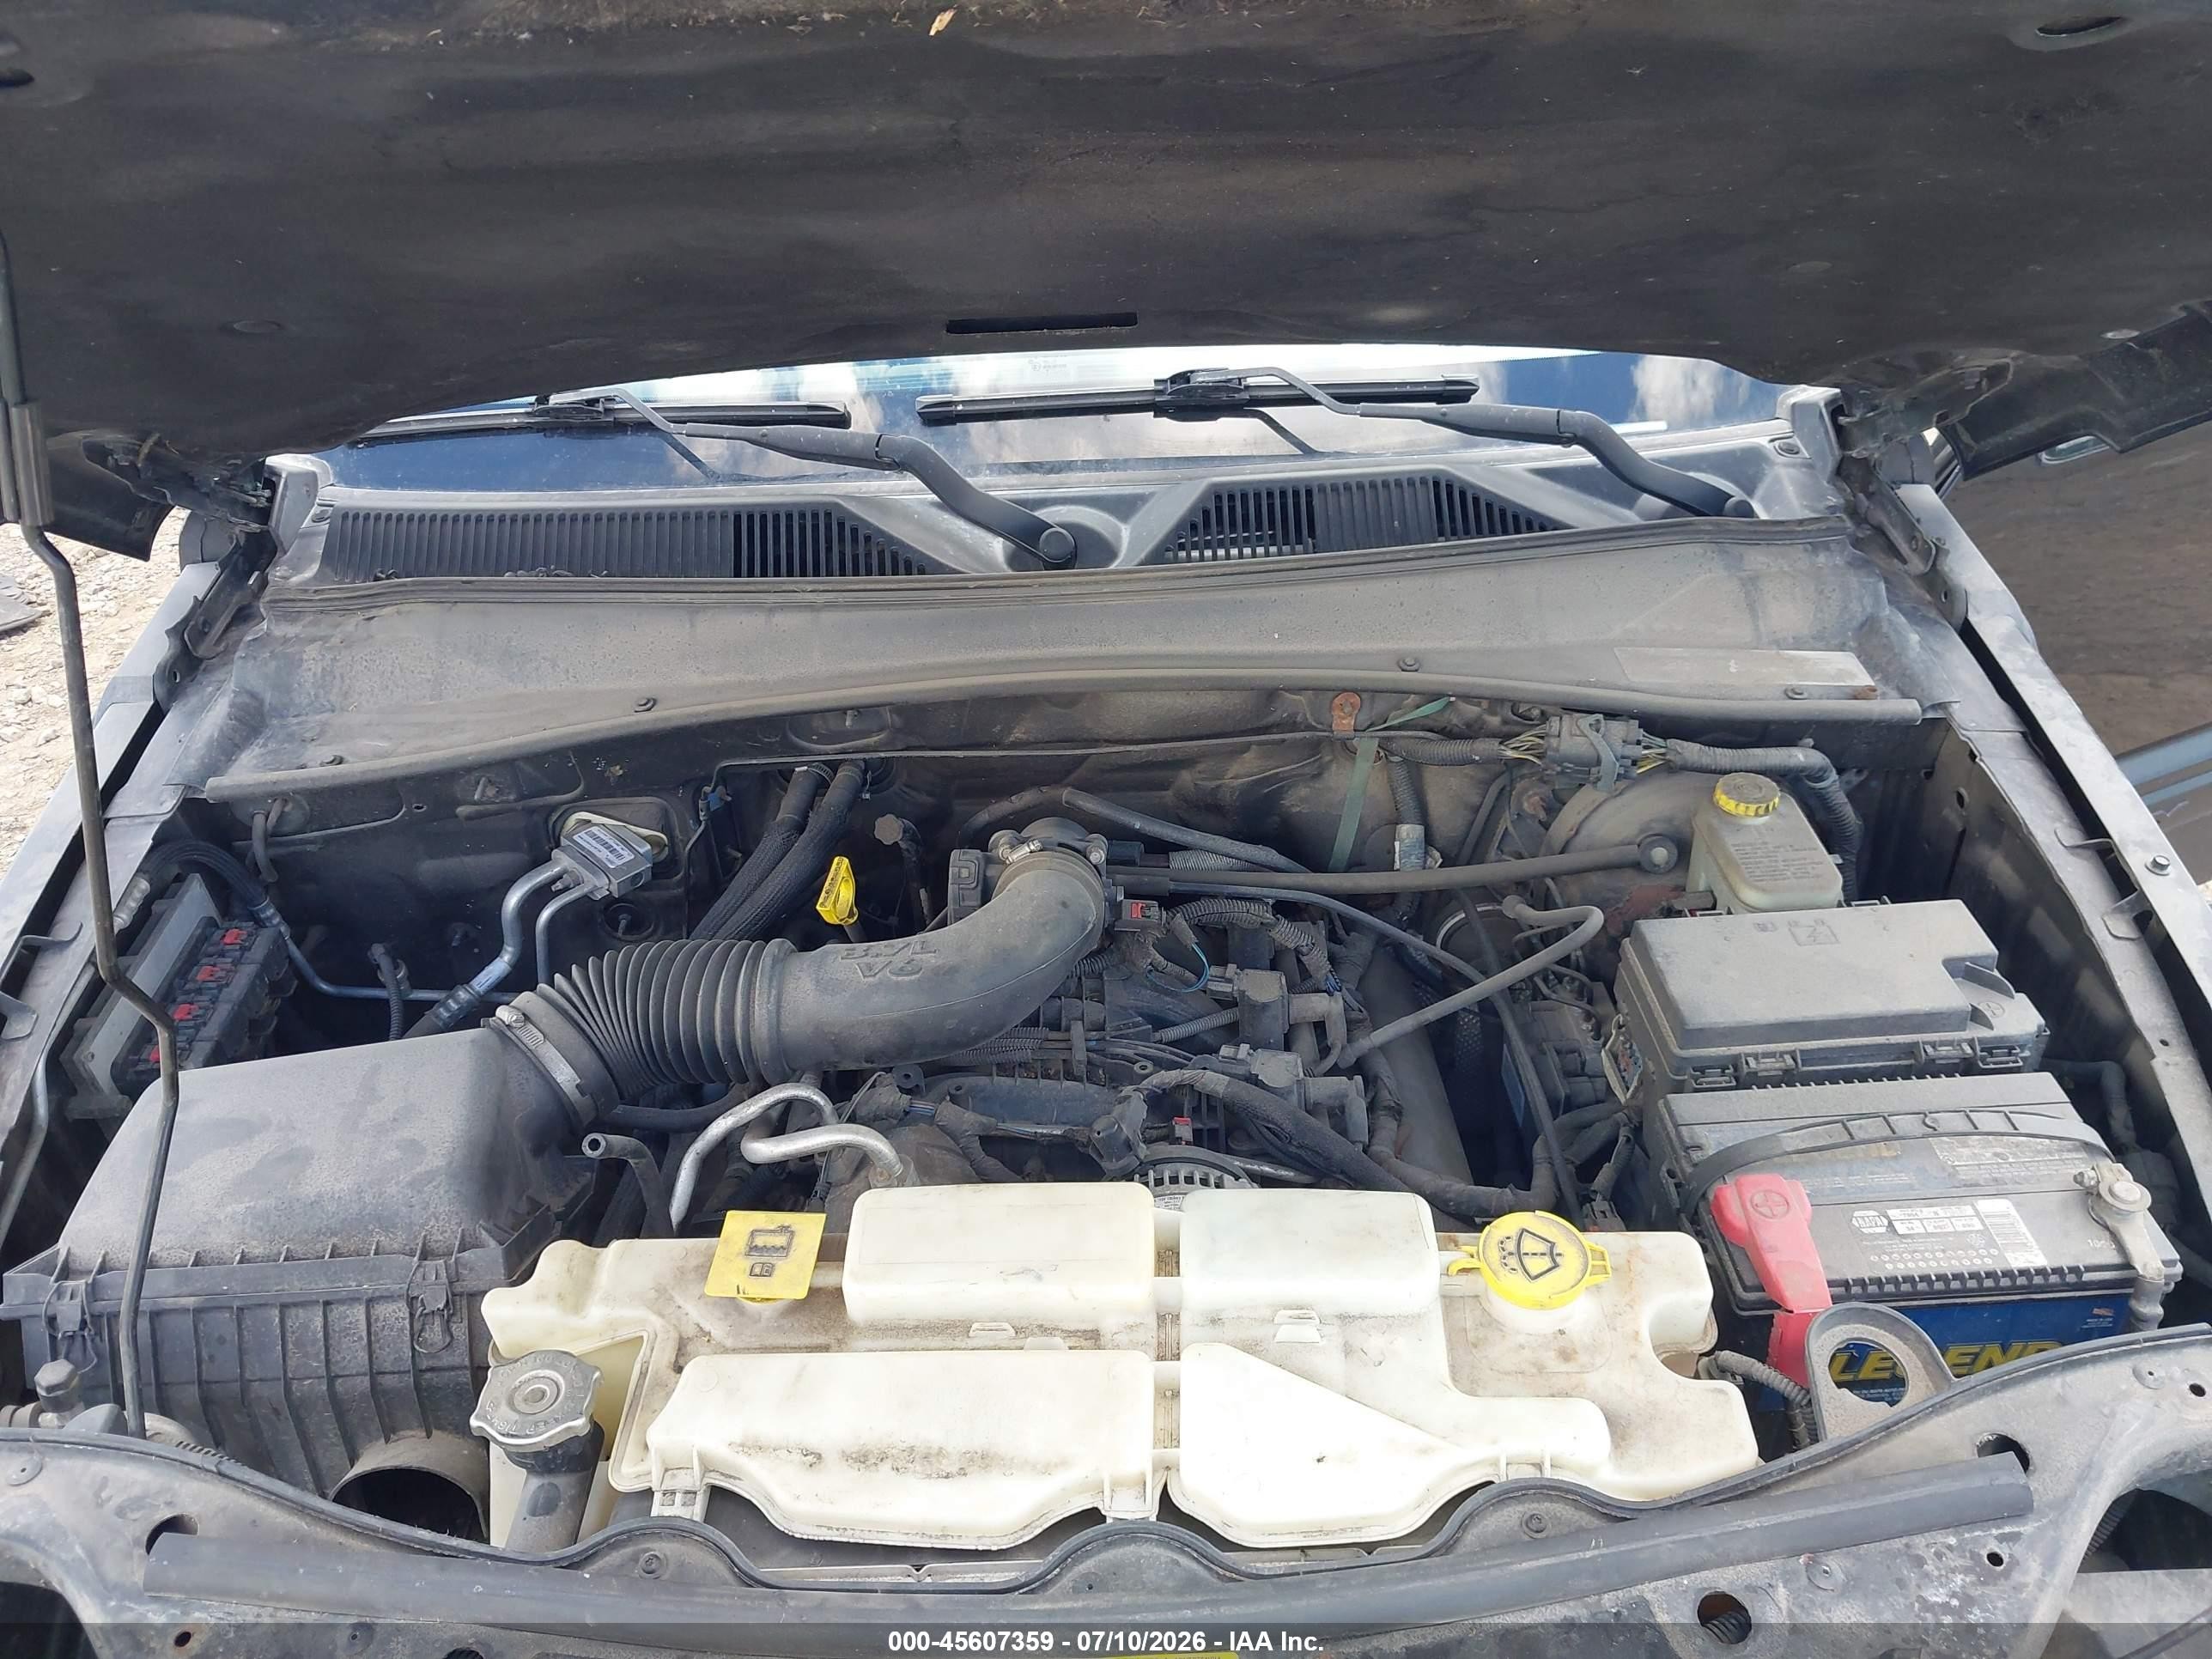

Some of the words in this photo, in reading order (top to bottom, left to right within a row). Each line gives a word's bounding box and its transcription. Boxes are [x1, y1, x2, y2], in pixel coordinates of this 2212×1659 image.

[854, 959, 923, 980] V6
[1855, 1215, 1885, 1229] NAPA
[1829, 1342, 2063, 1382] LEEN
